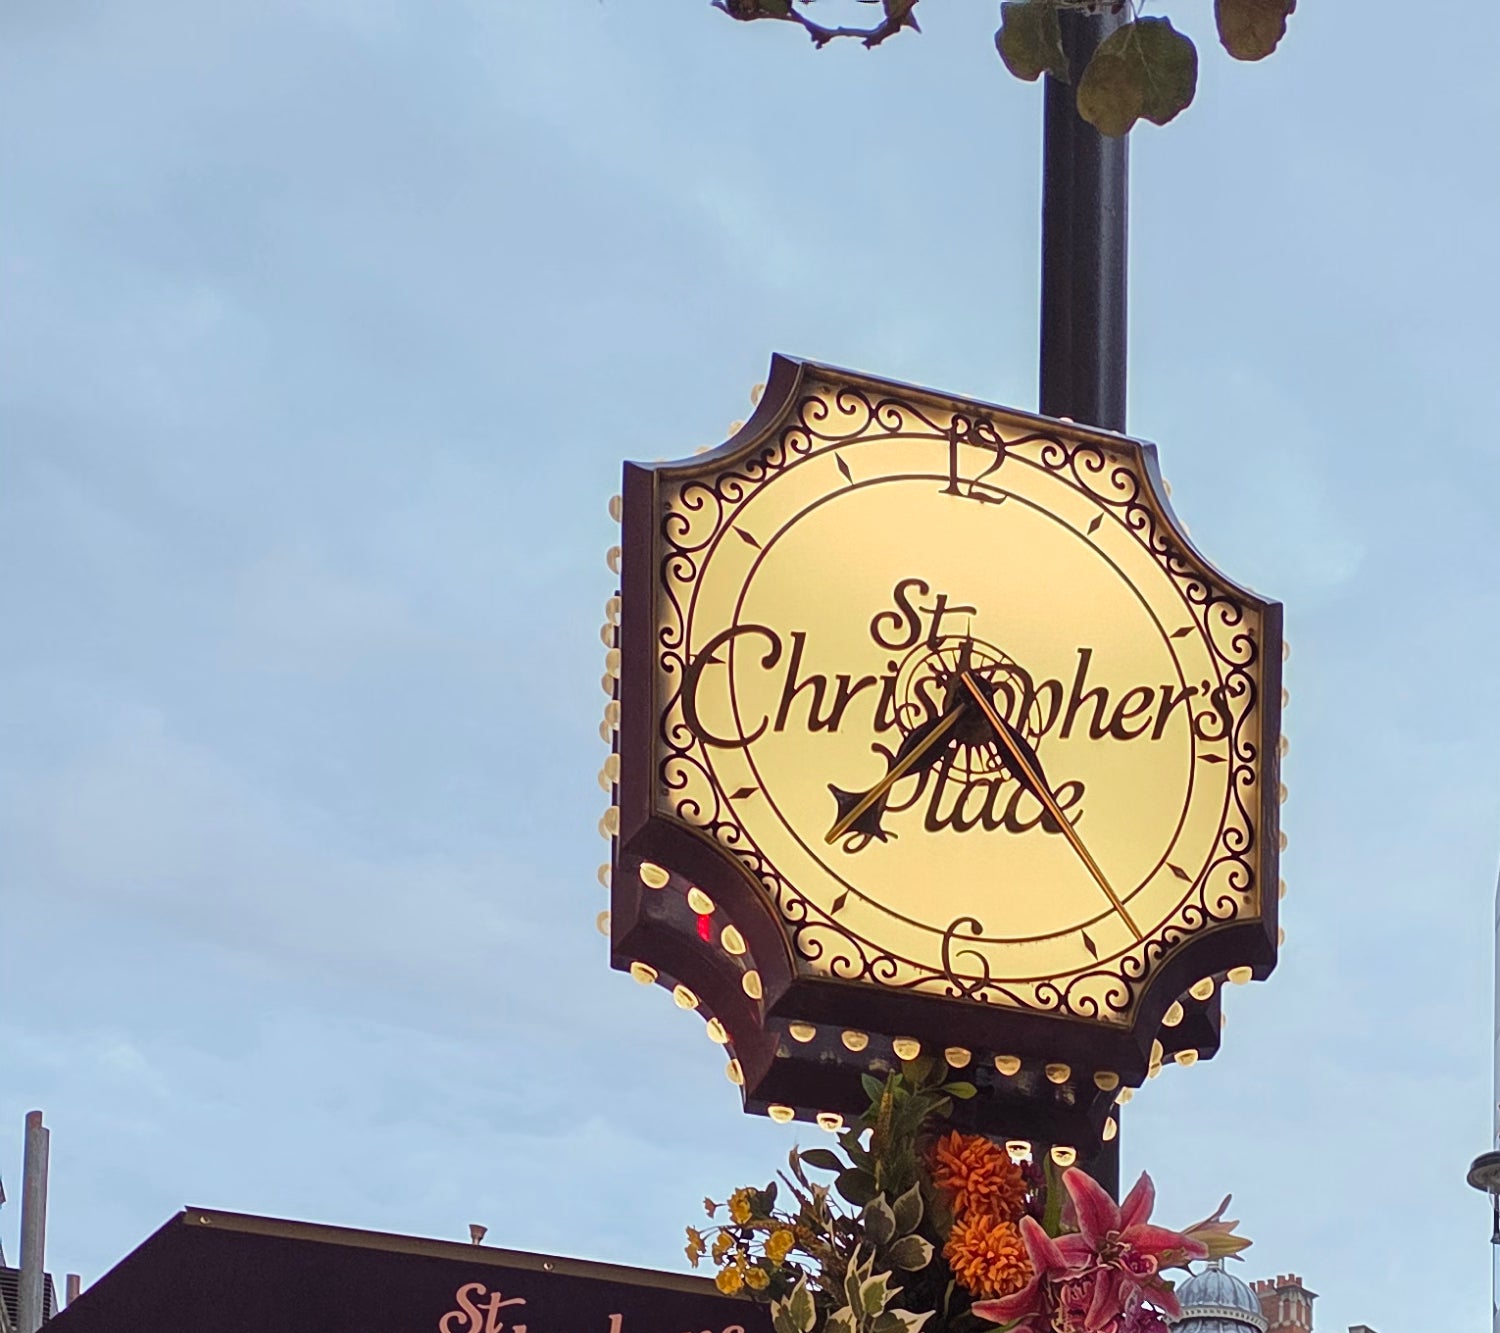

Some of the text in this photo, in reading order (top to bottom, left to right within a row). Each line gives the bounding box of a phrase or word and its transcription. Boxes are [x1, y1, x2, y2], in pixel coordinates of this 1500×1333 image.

[939, 413, 1008, 504] 12
[870, 578, 977, 651] St
[941, 917, 989, 997] 6
